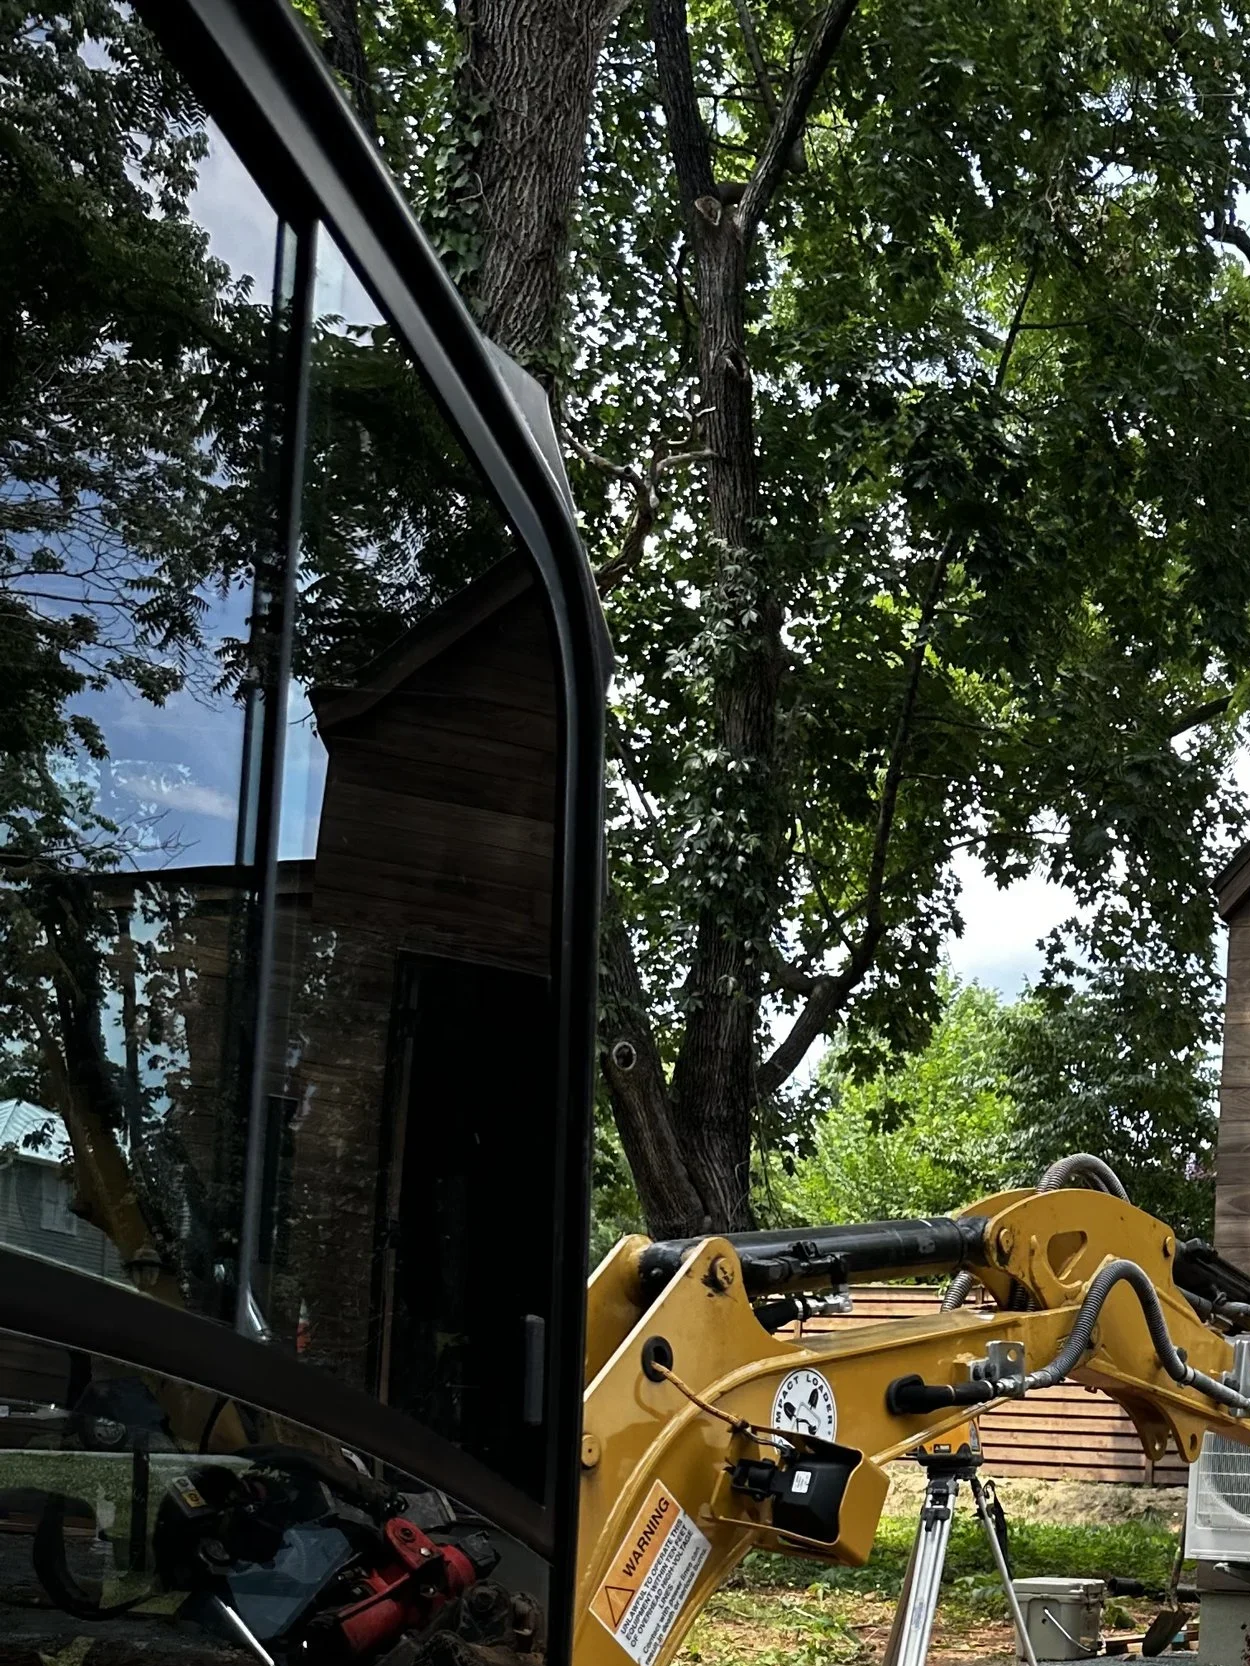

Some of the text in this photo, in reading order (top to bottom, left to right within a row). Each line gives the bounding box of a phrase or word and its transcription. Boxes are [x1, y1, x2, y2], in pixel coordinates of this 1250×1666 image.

[775, 1374, 833, 1430] MPACT LOADER
[619, 1518, 683, 1634] UNLAWFUL TO OPERATE THIS
[622, 1497, 670, 1577] WARNING
[624, 1524, 688, 1640] EQUIPMENT WITHIN TEN FEET
[629, 1528, 694, 1648] OF OVERHEAD HIGH-VOLTAGE
[642, 1621, 661, 1654] Contact
[658, 1604, 670, 1623] with
[667, 1580, 684, 1607] power
